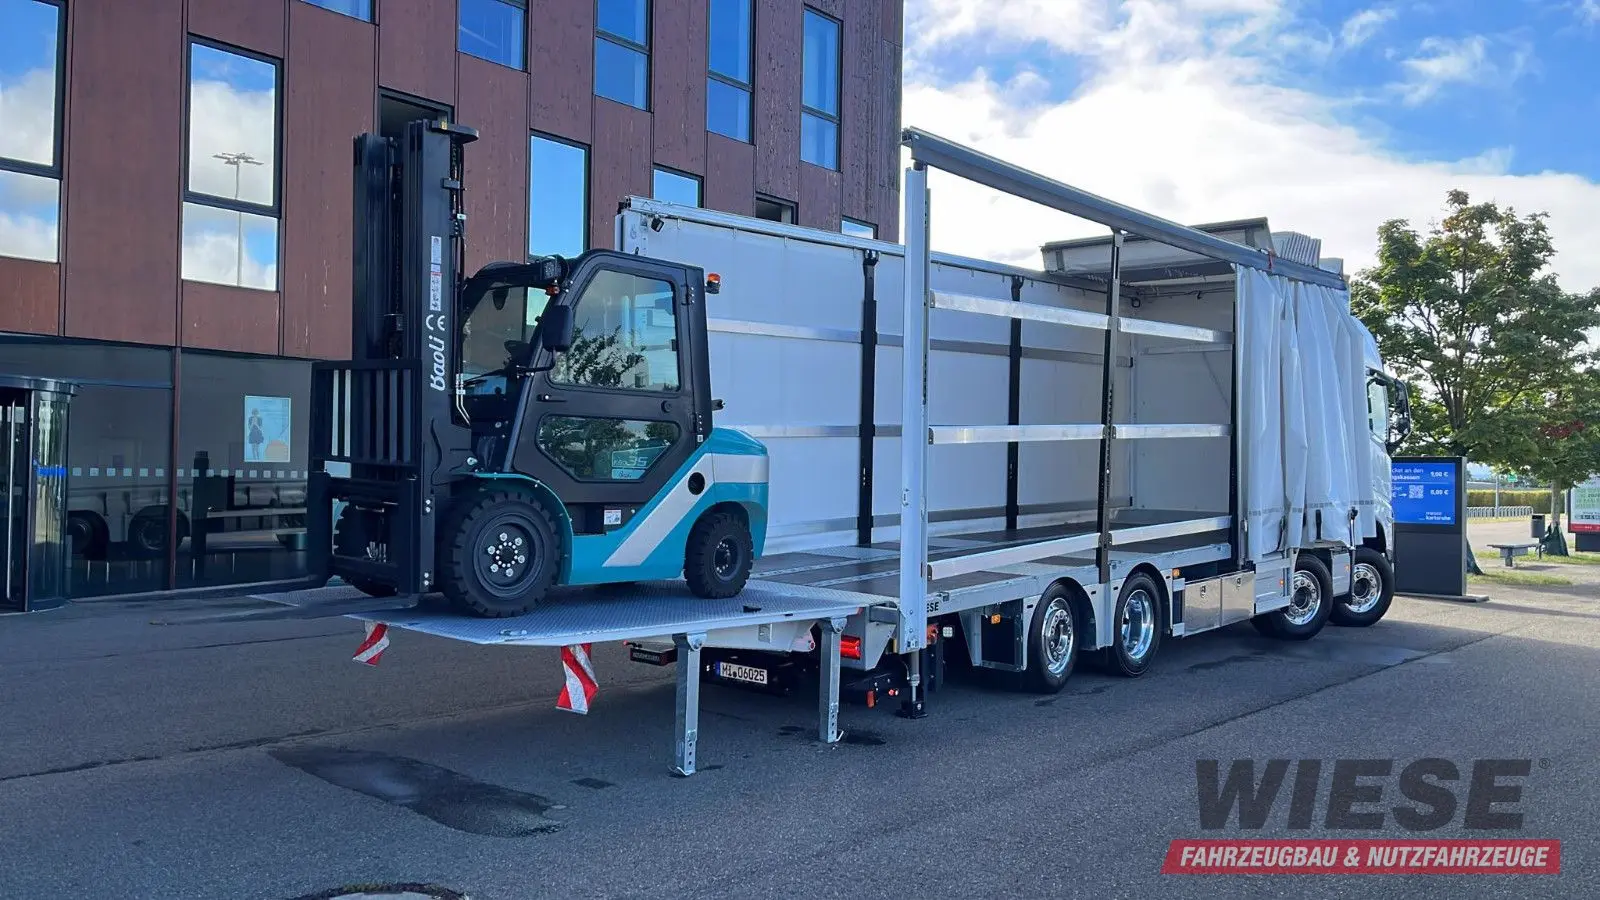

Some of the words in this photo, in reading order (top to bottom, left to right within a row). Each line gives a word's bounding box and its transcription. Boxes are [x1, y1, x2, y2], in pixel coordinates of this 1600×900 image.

[429, 335, 445, 391] baoli
[926, 601, 939, 613] ESE
[737, 668, 765, 681] 06025
